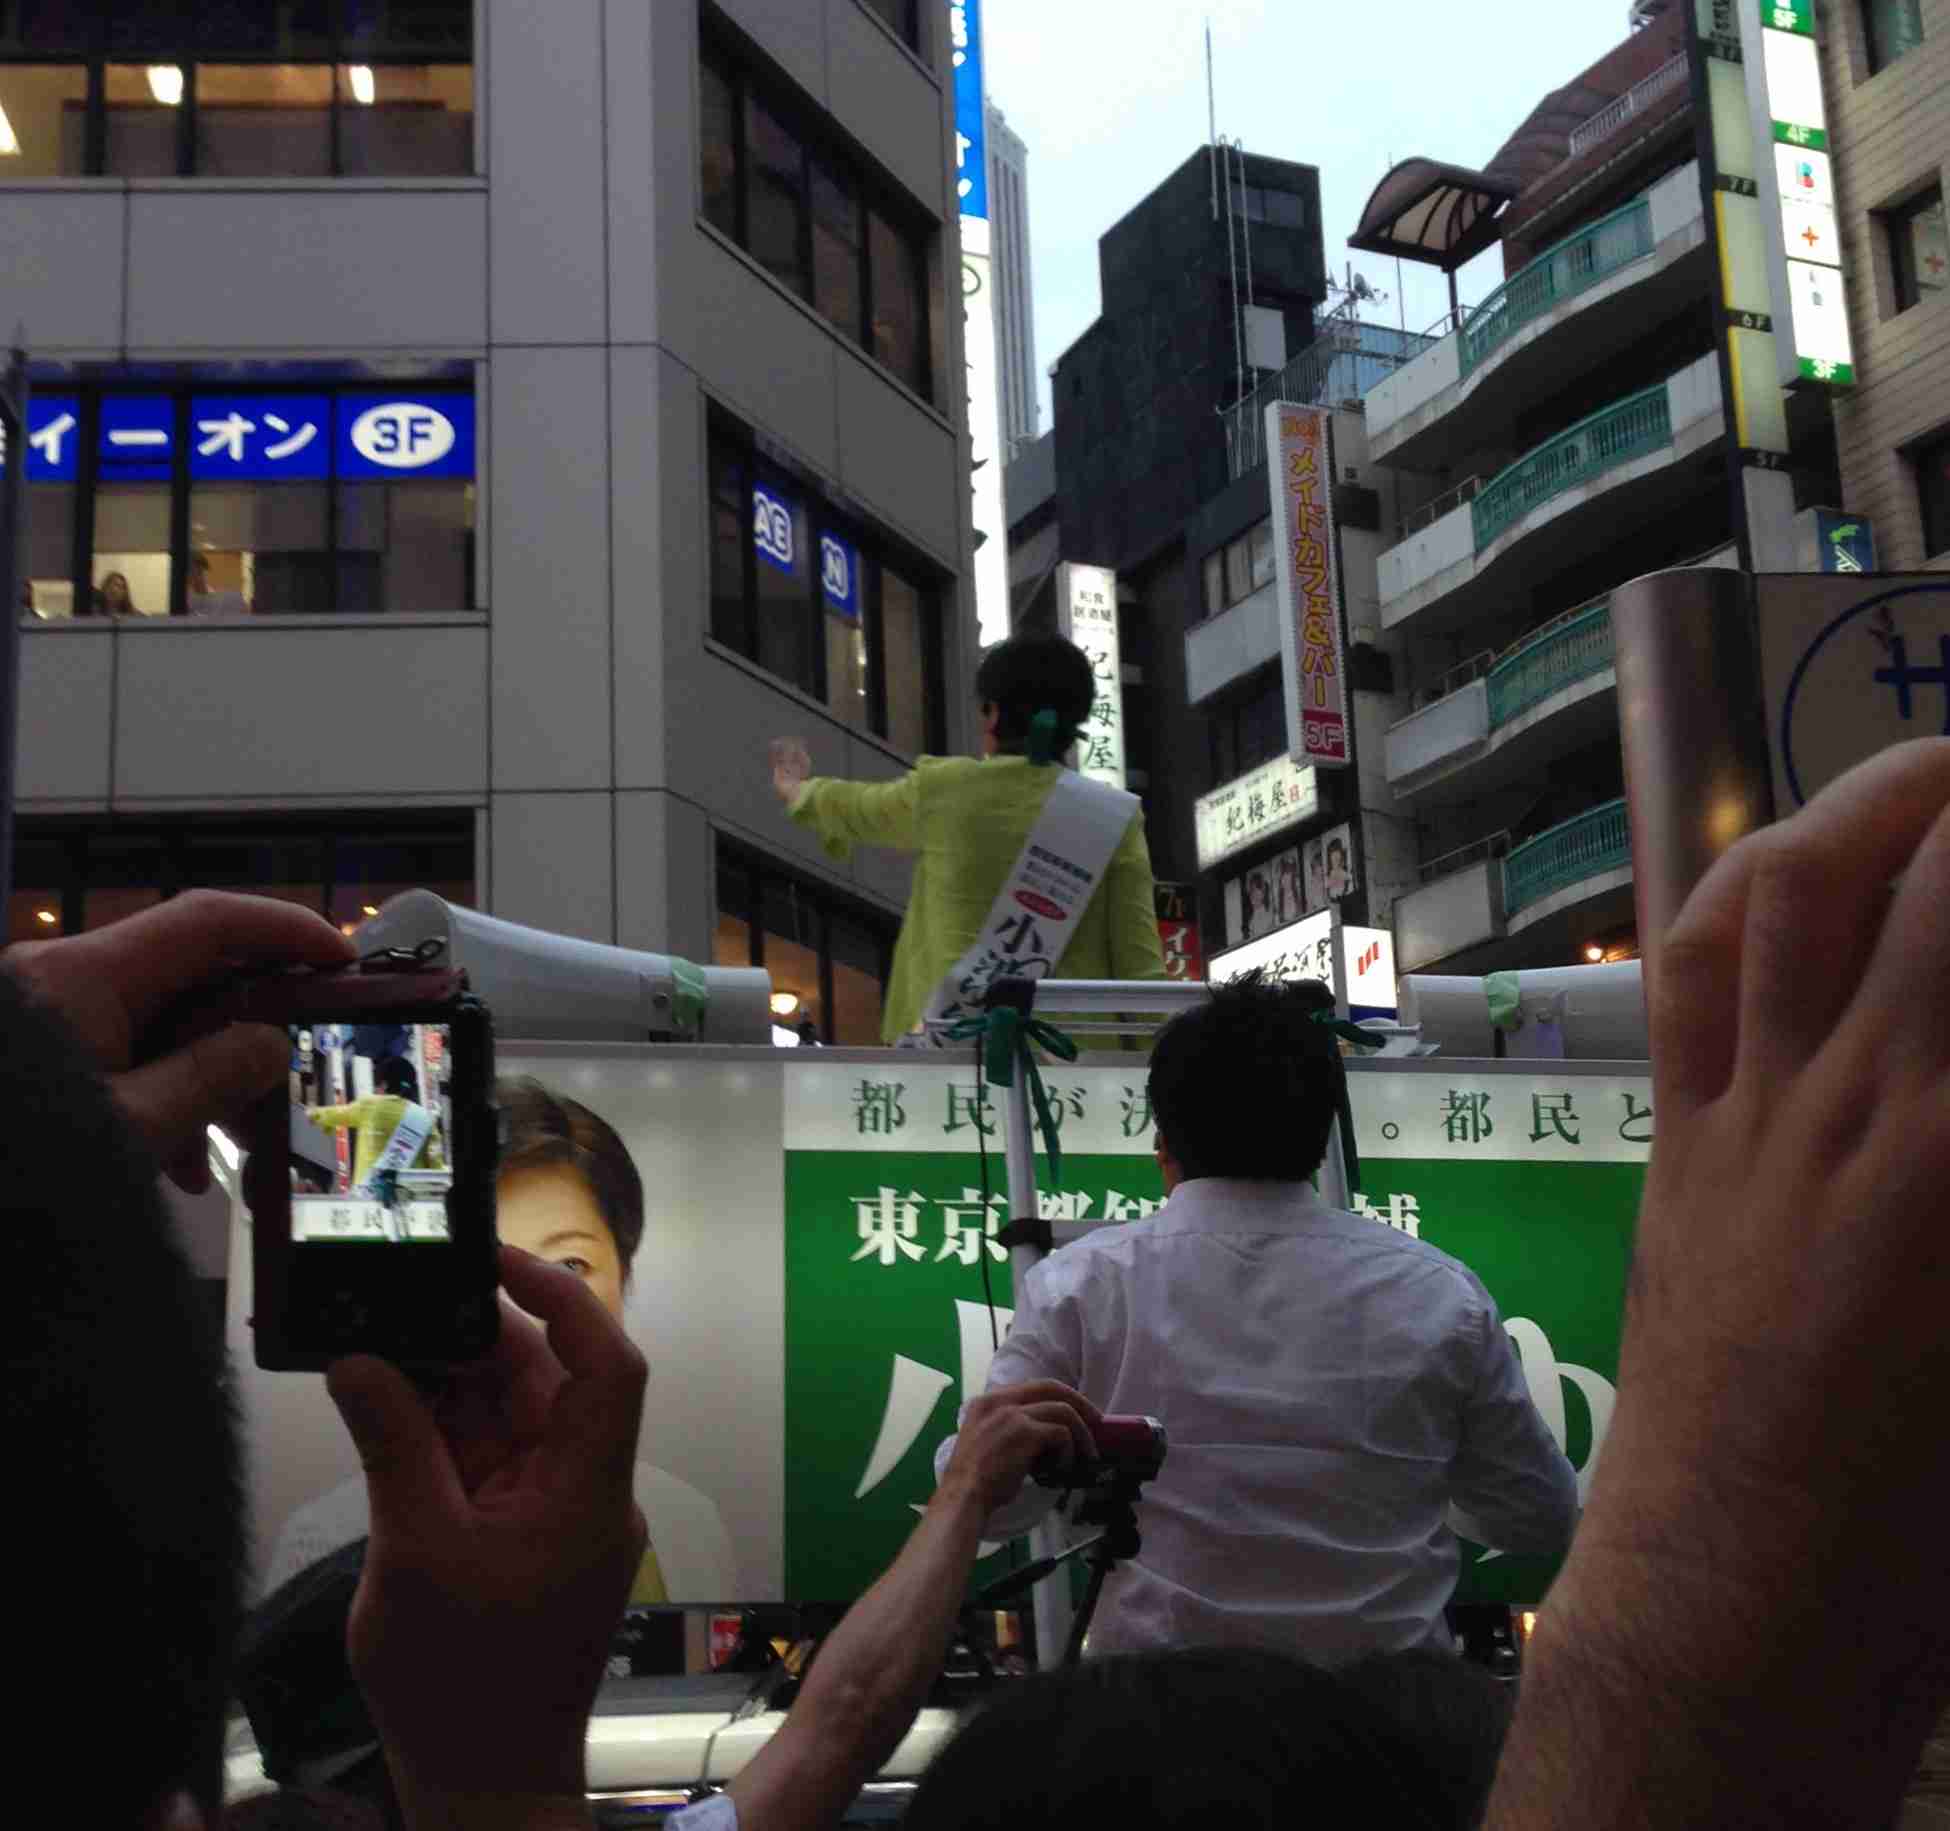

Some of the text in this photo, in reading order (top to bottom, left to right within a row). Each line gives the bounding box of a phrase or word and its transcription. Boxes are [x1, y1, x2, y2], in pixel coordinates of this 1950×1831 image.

[30, 411, 318, 465] イーオン
[372, 417, 434, 454] 3F
